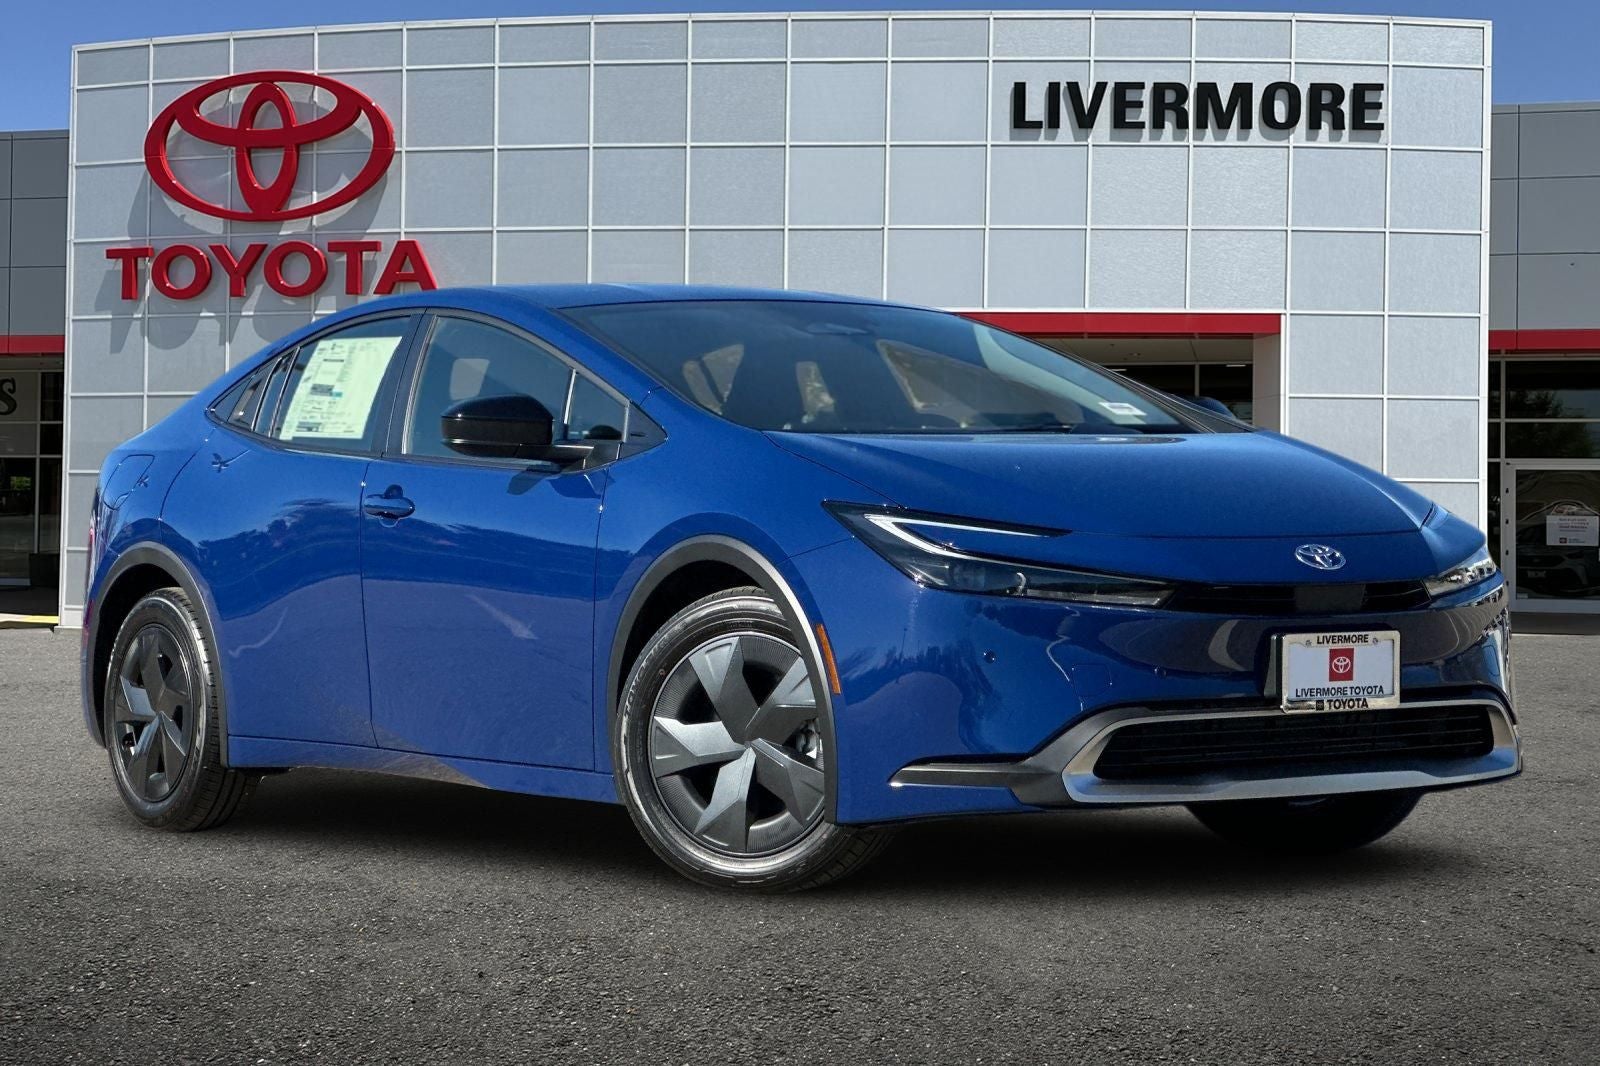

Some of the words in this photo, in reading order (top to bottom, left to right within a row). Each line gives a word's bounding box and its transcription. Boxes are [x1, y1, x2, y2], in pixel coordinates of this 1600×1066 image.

[1013, 81, 1385, 131] LIVERMORE
[106, 239, 438, 301] TOYOTA
[1316, 634, 1369, 645] LIVERMORE
[1295, 686, 1348, 698] LIVERMORE
[1350, 685, 1384, 695] TOYOTA
[1328, 698, 1369, 710] TOYOTA
